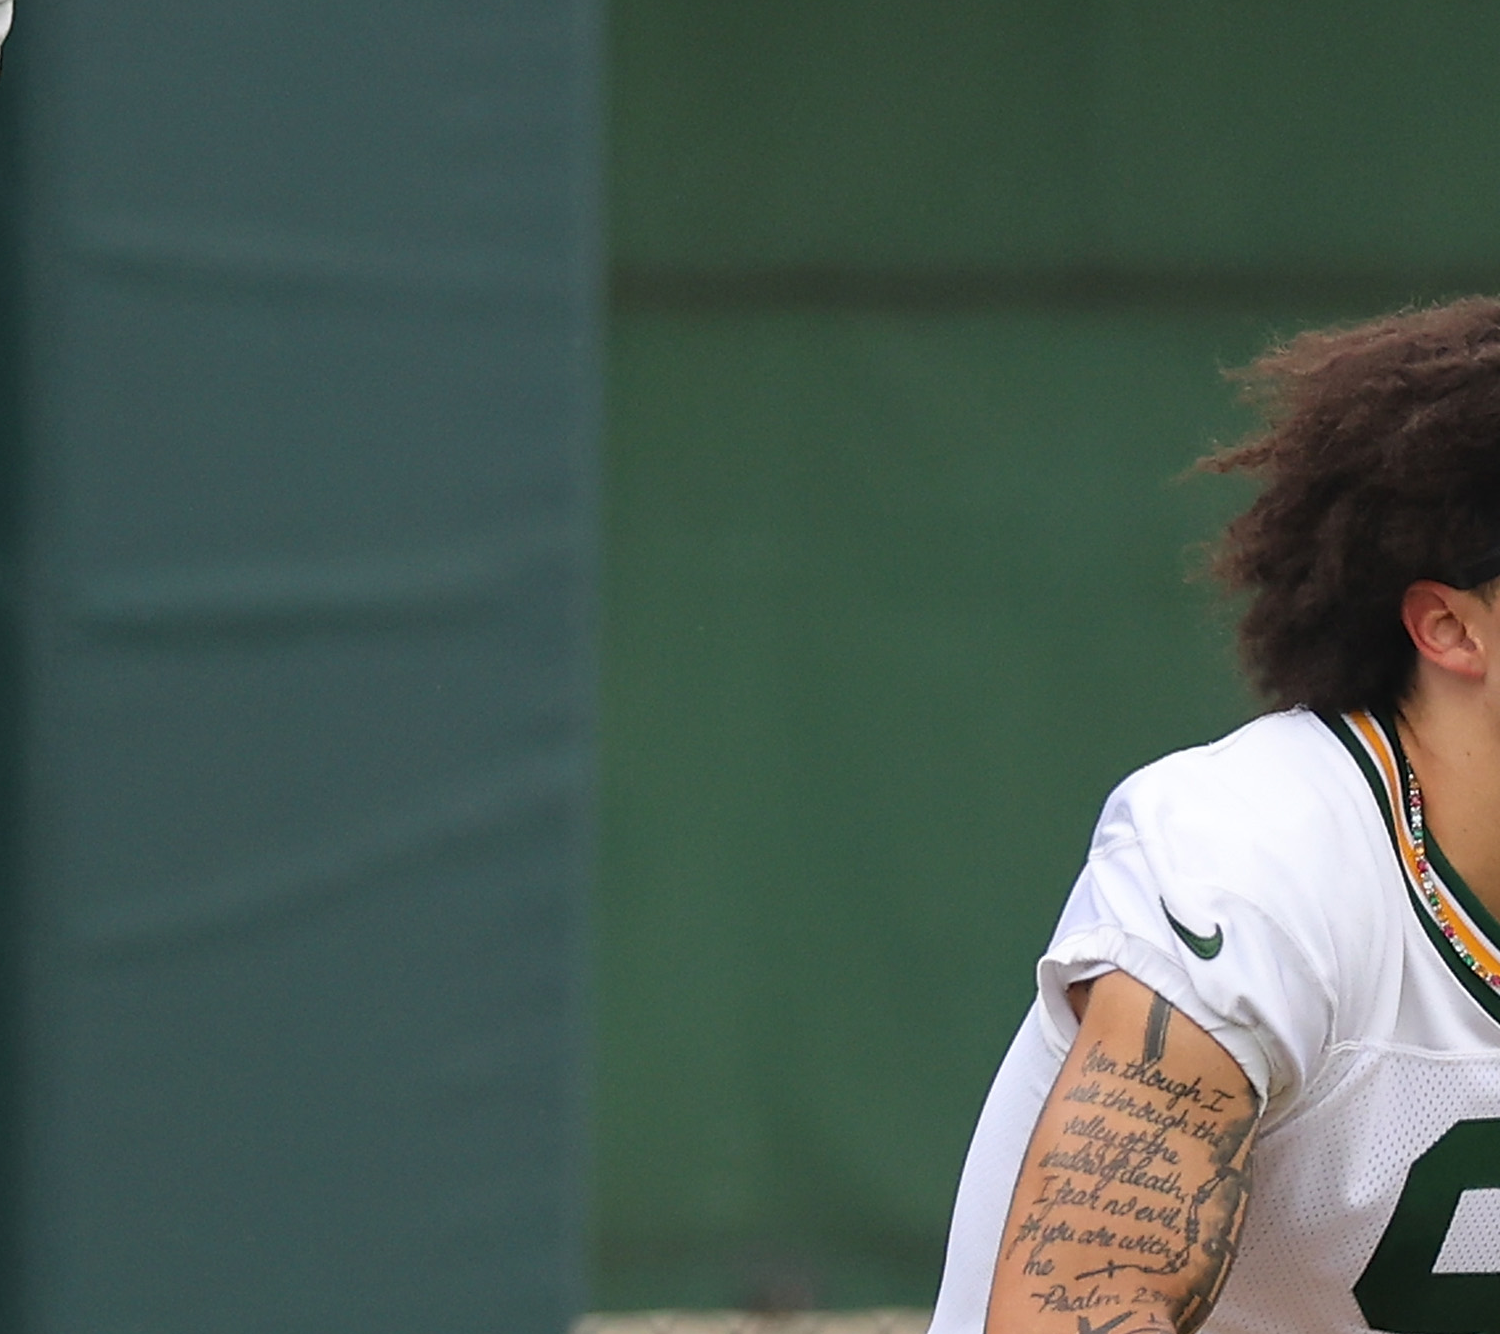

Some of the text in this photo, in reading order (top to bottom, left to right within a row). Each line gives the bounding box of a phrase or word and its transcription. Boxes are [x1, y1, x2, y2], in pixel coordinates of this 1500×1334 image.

[1119, 1056, 1202, 1111] though
[1201, 1088, 1235, 1113] I
[1100, 1087, 1188, 1138] through
[1032, 1174, 1060, 1205] I
[1036, 1177, 1101, 1223] fear
[1102, 1195, 1138, 1216] no
[1030, 1219, 1075, 1259] you
[1077, 1225, 1117, 1247] are
[1118, 1232, 1173, 1258] with
[1023, 1257, 1055, 1276] me
